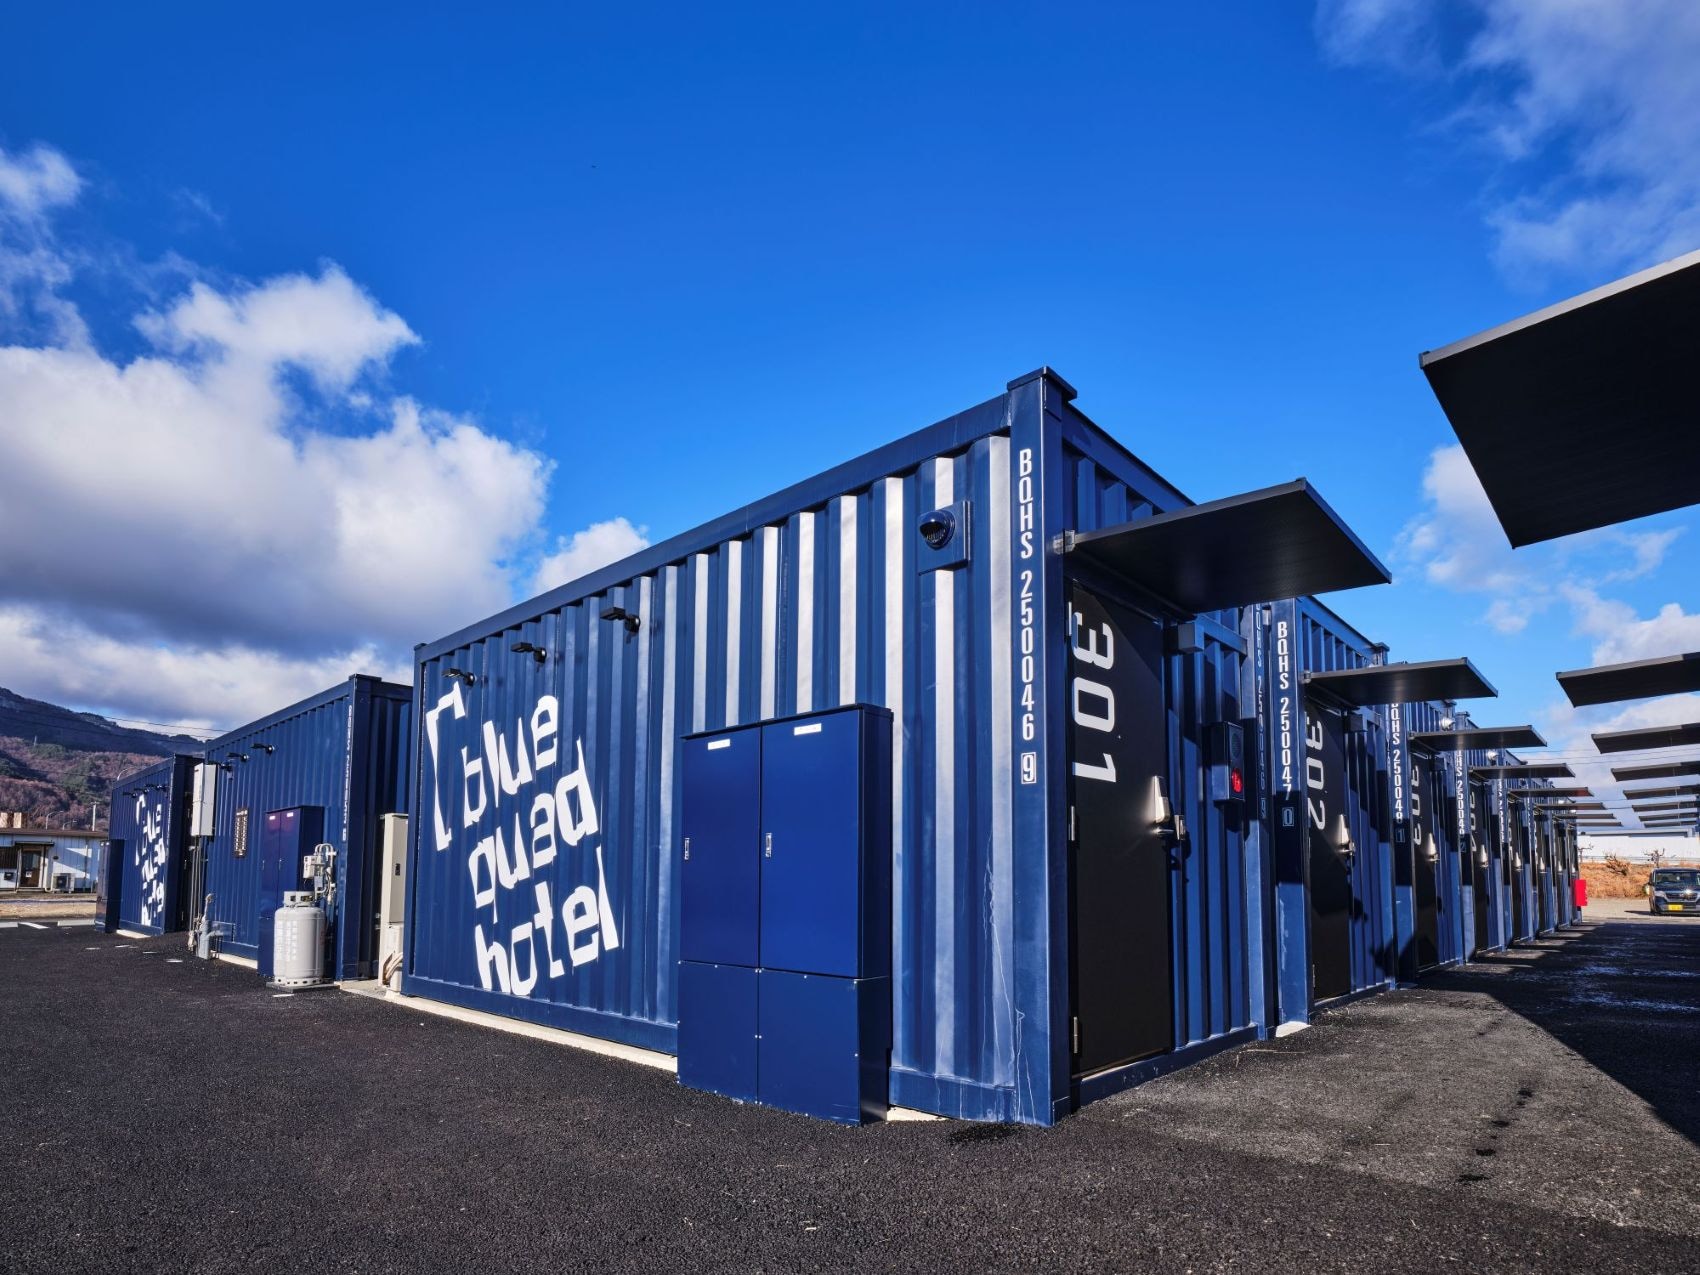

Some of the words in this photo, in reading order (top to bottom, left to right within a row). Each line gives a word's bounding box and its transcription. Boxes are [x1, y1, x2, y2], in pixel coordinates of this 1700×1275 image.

[1018, 448, 1033, 560] BQHS
[1020, 570, 1035, 742] 250046
[1071, 611, 1117, 783] 301
[1277, 621, 1289, 690] BQHS
[462, 695, 558, 828] blue
[1022, 753, 1036, 783] 9
[1280, 697, 1292, 800] 250047
[1305, 716, 1326, 830] 302
[1393, 749, 1403, 824] 250048
[469, 736, 598, 924] quad
[1283, 807, 1294, 827] 0
[475, 846, 620, 996] hotel
